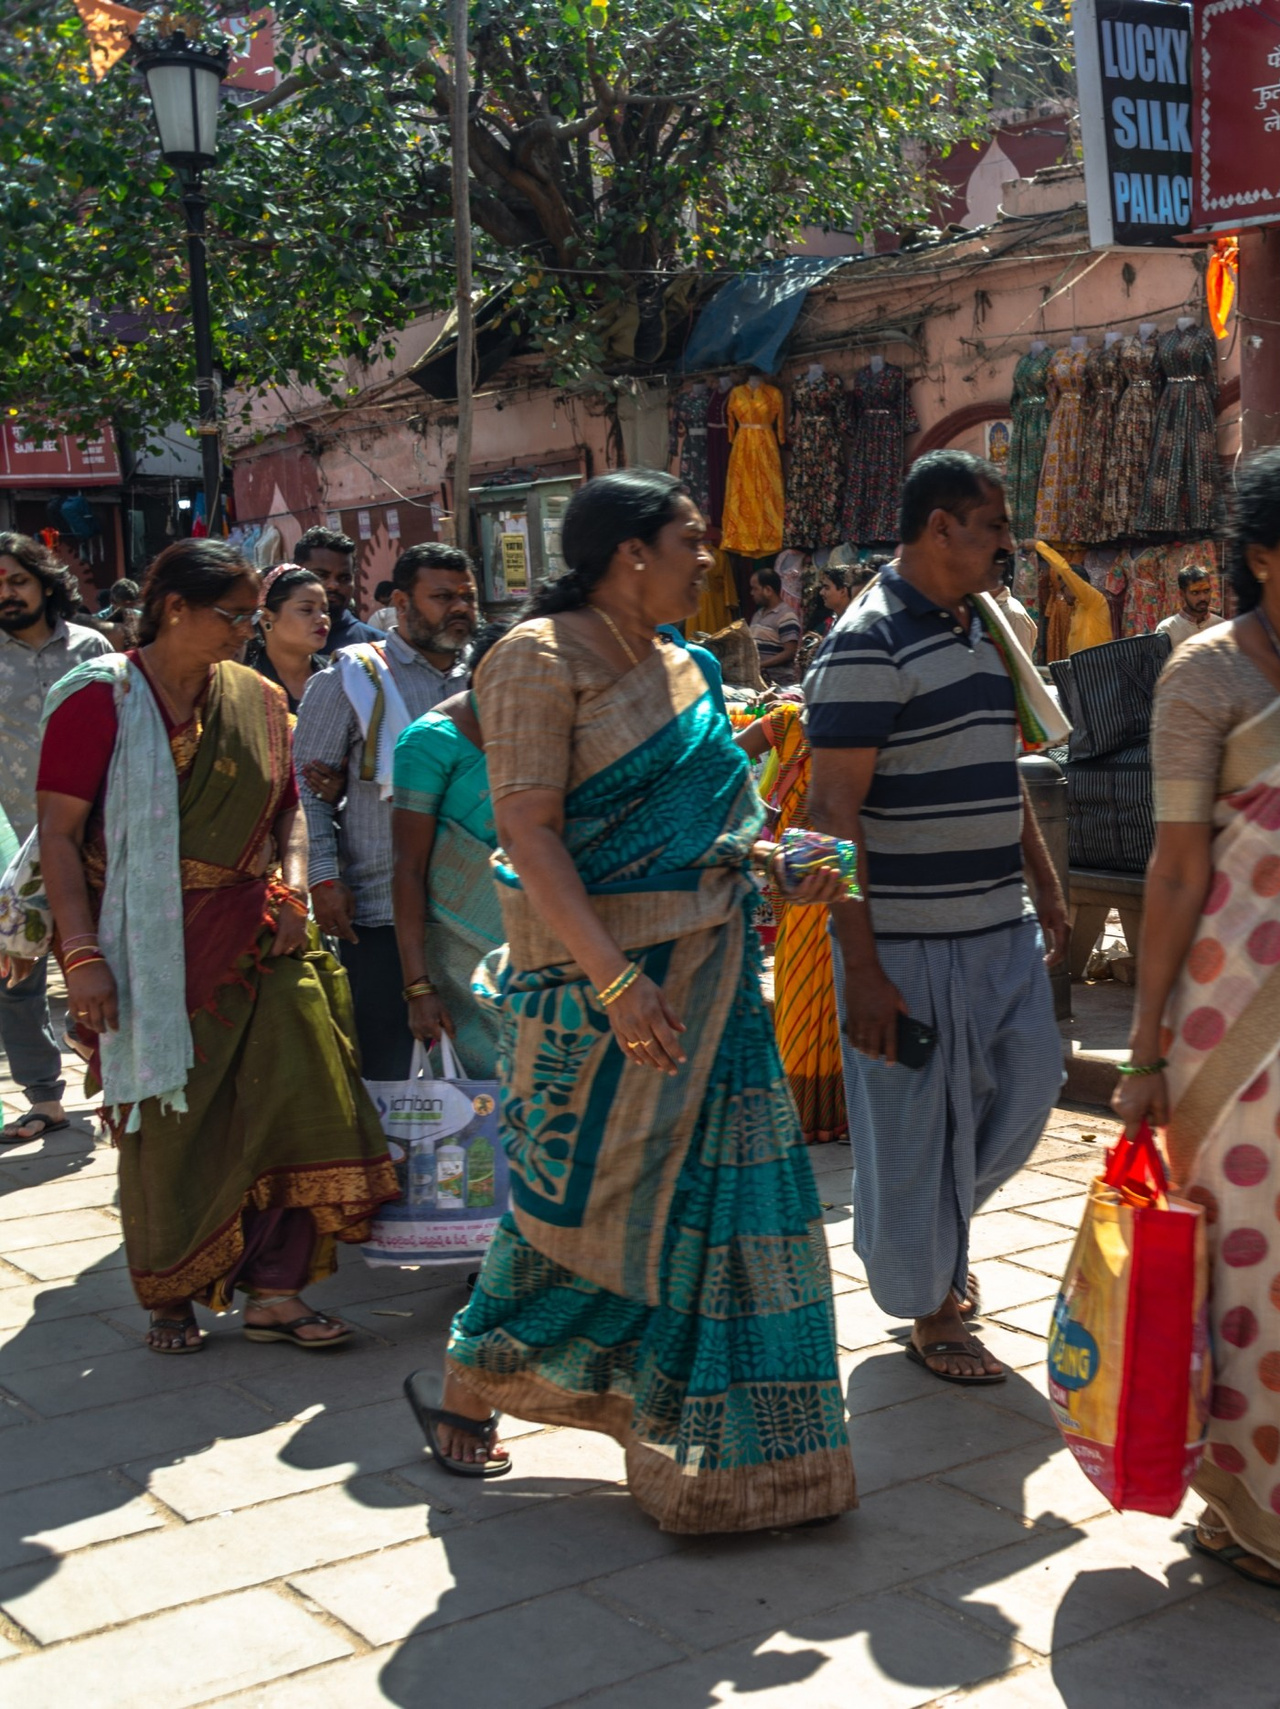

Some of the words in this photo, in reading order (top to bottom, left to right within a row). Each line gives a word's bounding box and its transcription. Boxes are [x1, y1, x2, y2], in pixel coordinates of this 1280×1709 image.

[1101, 20, 1188, 85] LUCKY
[1111, 96, 1192, 153] SILK
[1113, 172, 1192, 226] PALAC
[390, 1095, 443, 1111] ichiban
